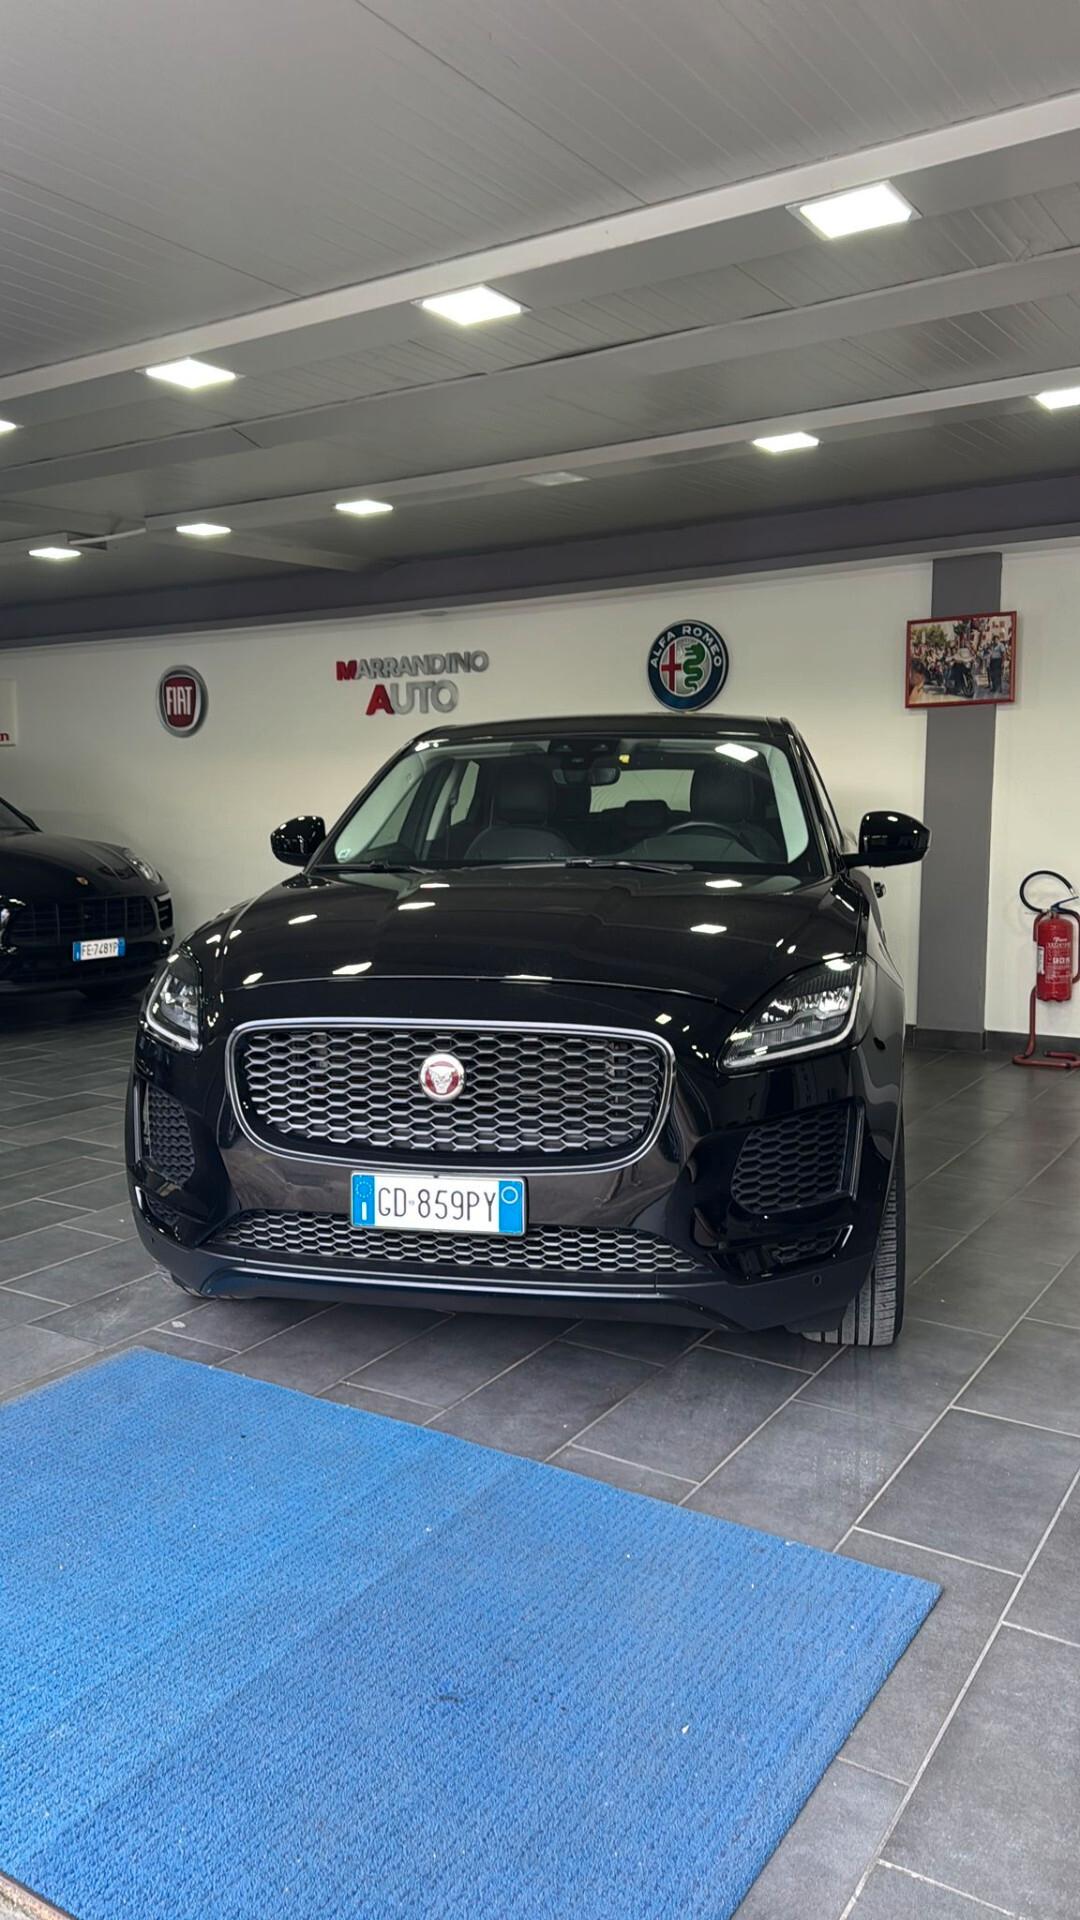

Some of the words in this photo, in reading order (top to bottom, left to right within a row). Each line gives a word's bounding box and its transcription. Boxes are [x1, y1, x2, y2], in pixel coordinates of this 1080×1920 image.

[650, 631, 676, 668] ALFA
[682, 625, 722, 667] ROMEO
[336, 650, 489, 681] MARRANDINO
[165, 686, 193, 716] FIAT
[366, 679, 459, 716] AUTO
